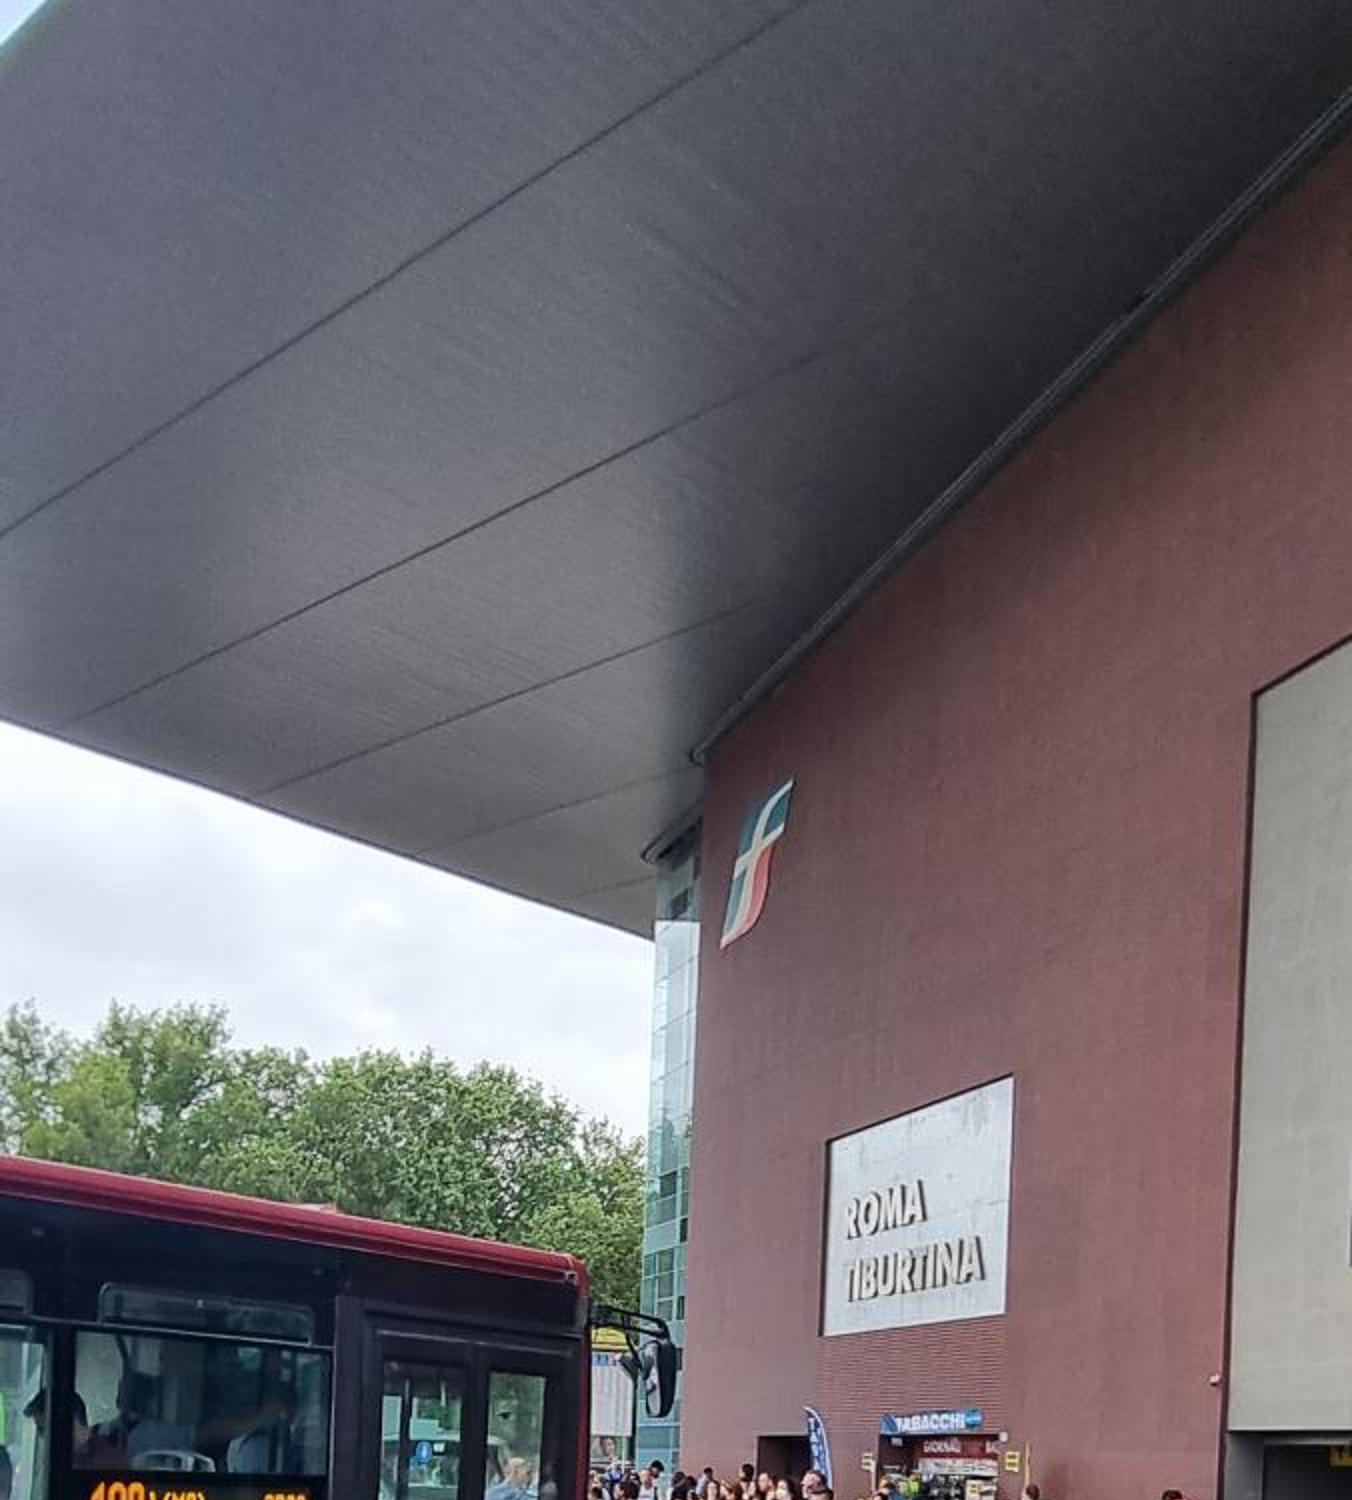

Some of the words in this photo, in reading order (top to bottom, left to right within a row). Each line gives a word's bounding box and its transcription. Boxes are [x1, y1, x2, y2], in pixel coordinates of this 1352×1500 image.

[846, 1179, 927, 1240] ROMA
[845, 1235, 986, 1303] TIBURTINA
[894, 1413, 965, 1432] TABACCHI
